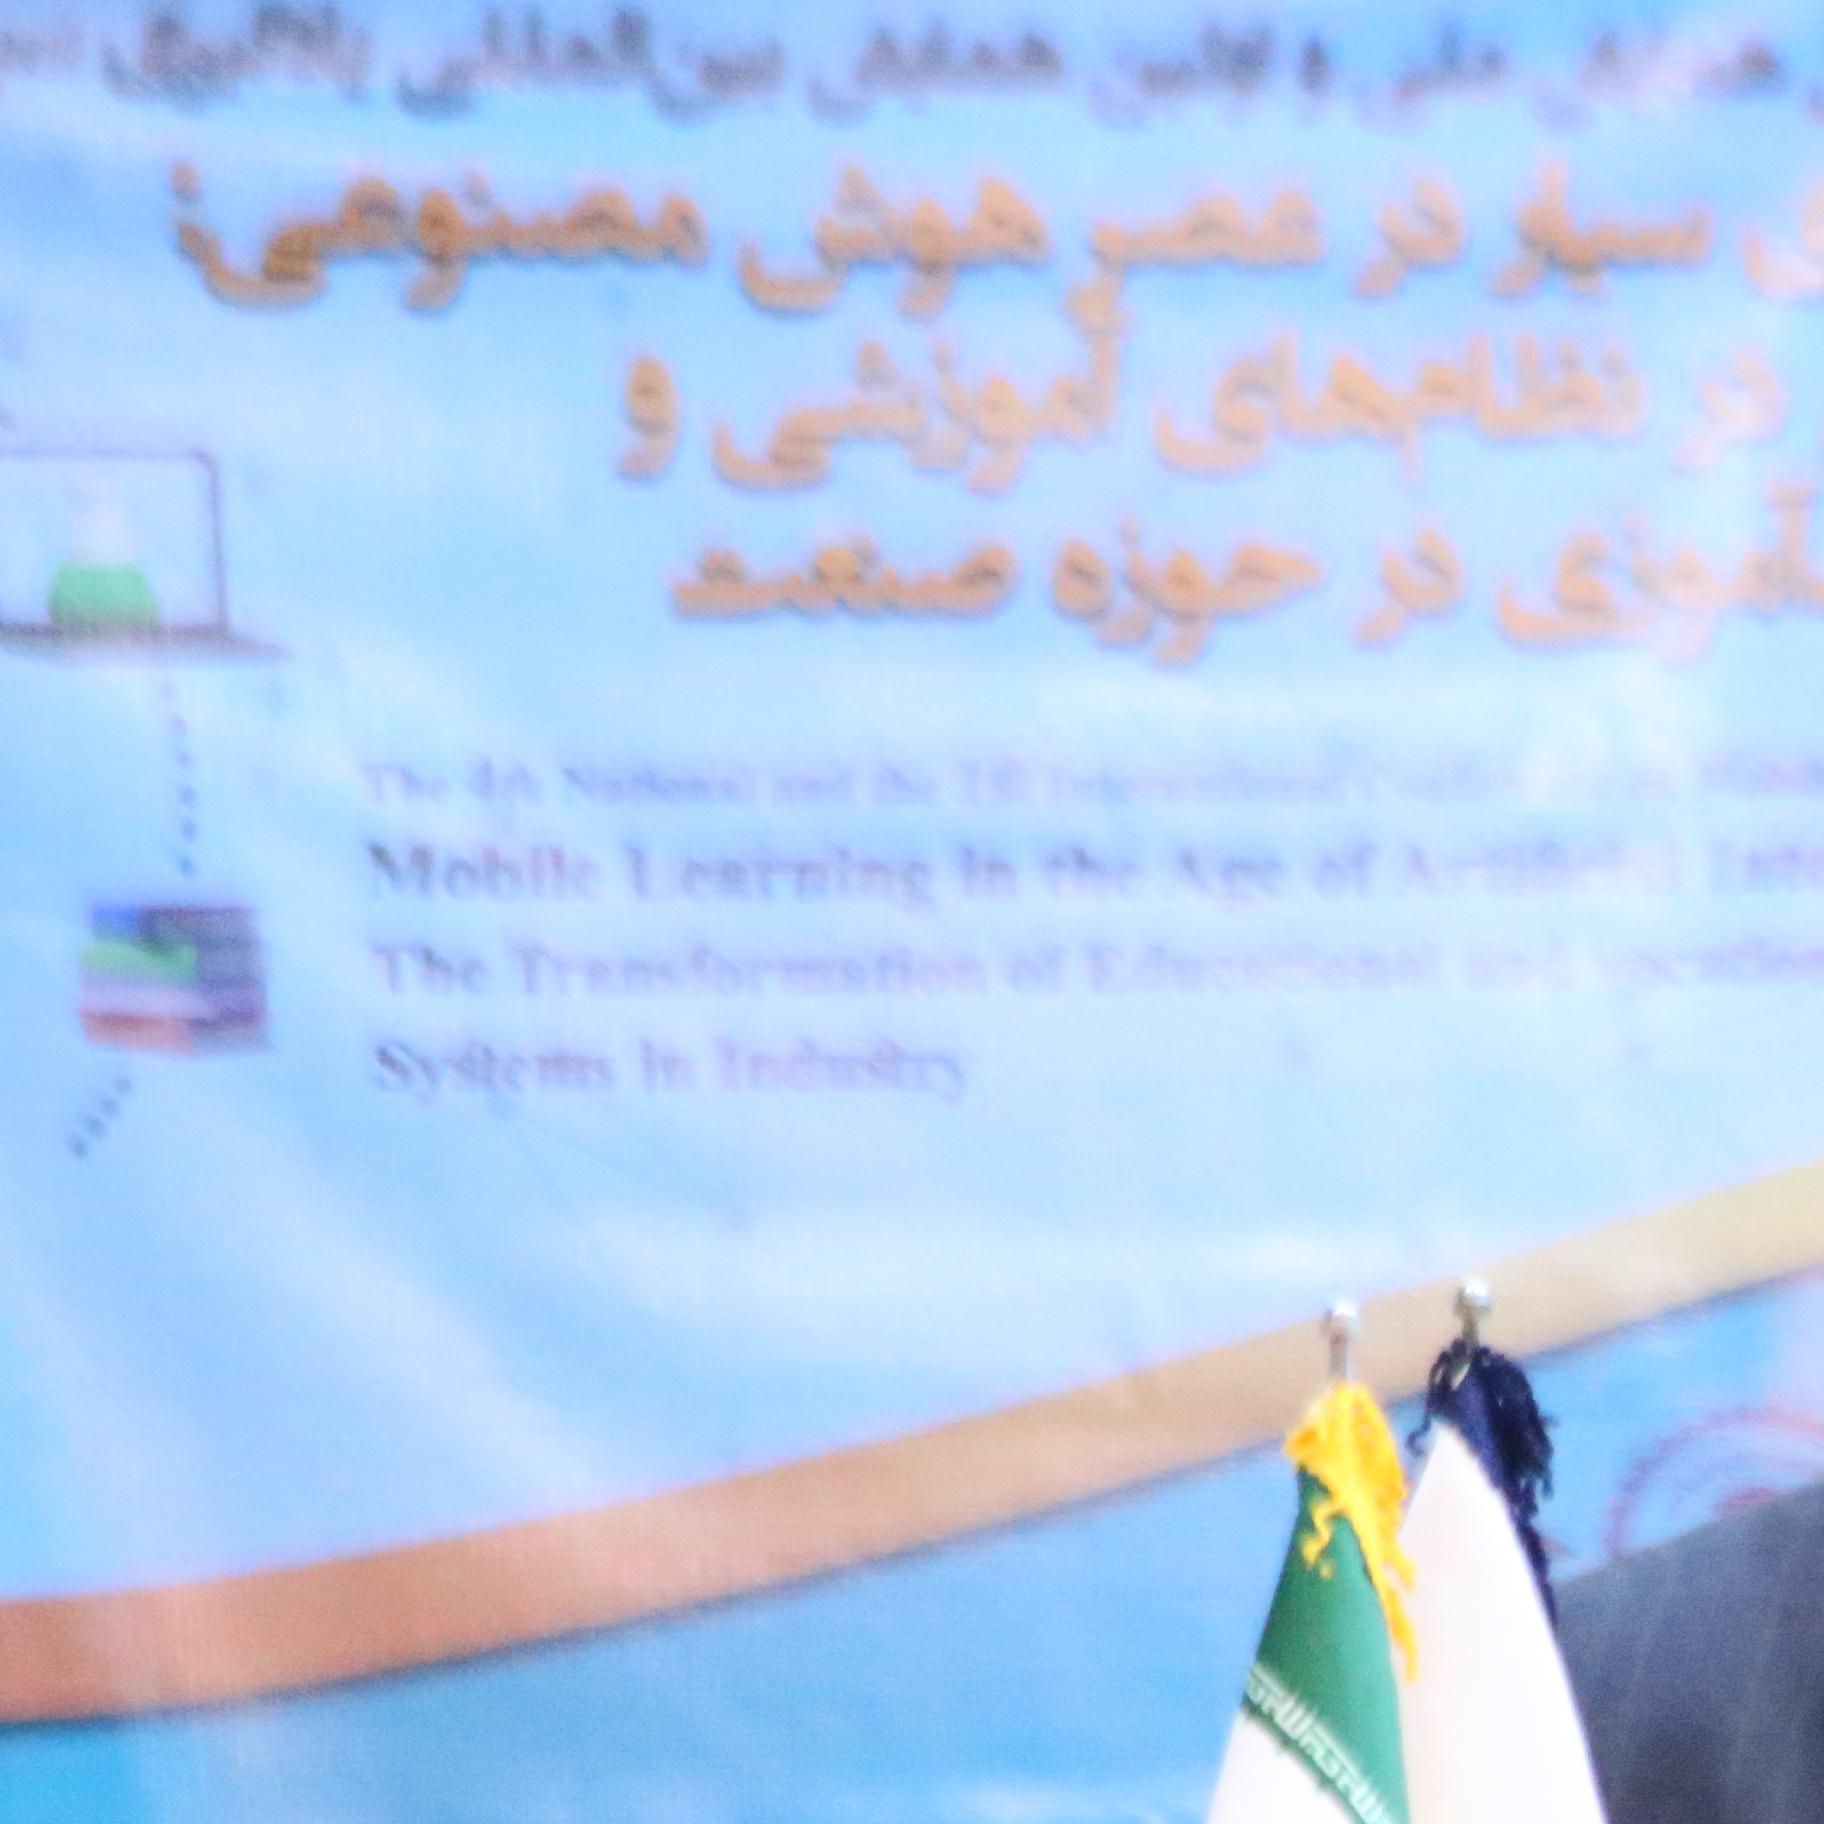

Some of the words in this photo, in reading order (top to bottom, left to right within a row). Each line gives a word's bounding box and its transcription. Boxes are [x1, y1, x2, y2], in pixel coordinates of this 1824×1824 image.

[738, 163, 1050, 316] هوش
[1357, 528, 1462, 645] در
[370, 842, 598, 901] Mobile
[626, 842, 934, 914] Learning
[959, 842, 1018, 902] in
[1045, 842, 1144, 902] the
[1172, 842, 1286, 906] Age
[1308, 838, 1378, 897] of
[374, 944, 488, 997] The
[508, 942, 983, 997] Transformation
[1007, 940, 1065, 995] of
[370, 1040, 618, 1107] Systems
[638, 1040, 695, 1094] in
[718, 1040, 970, 1108] Industry
